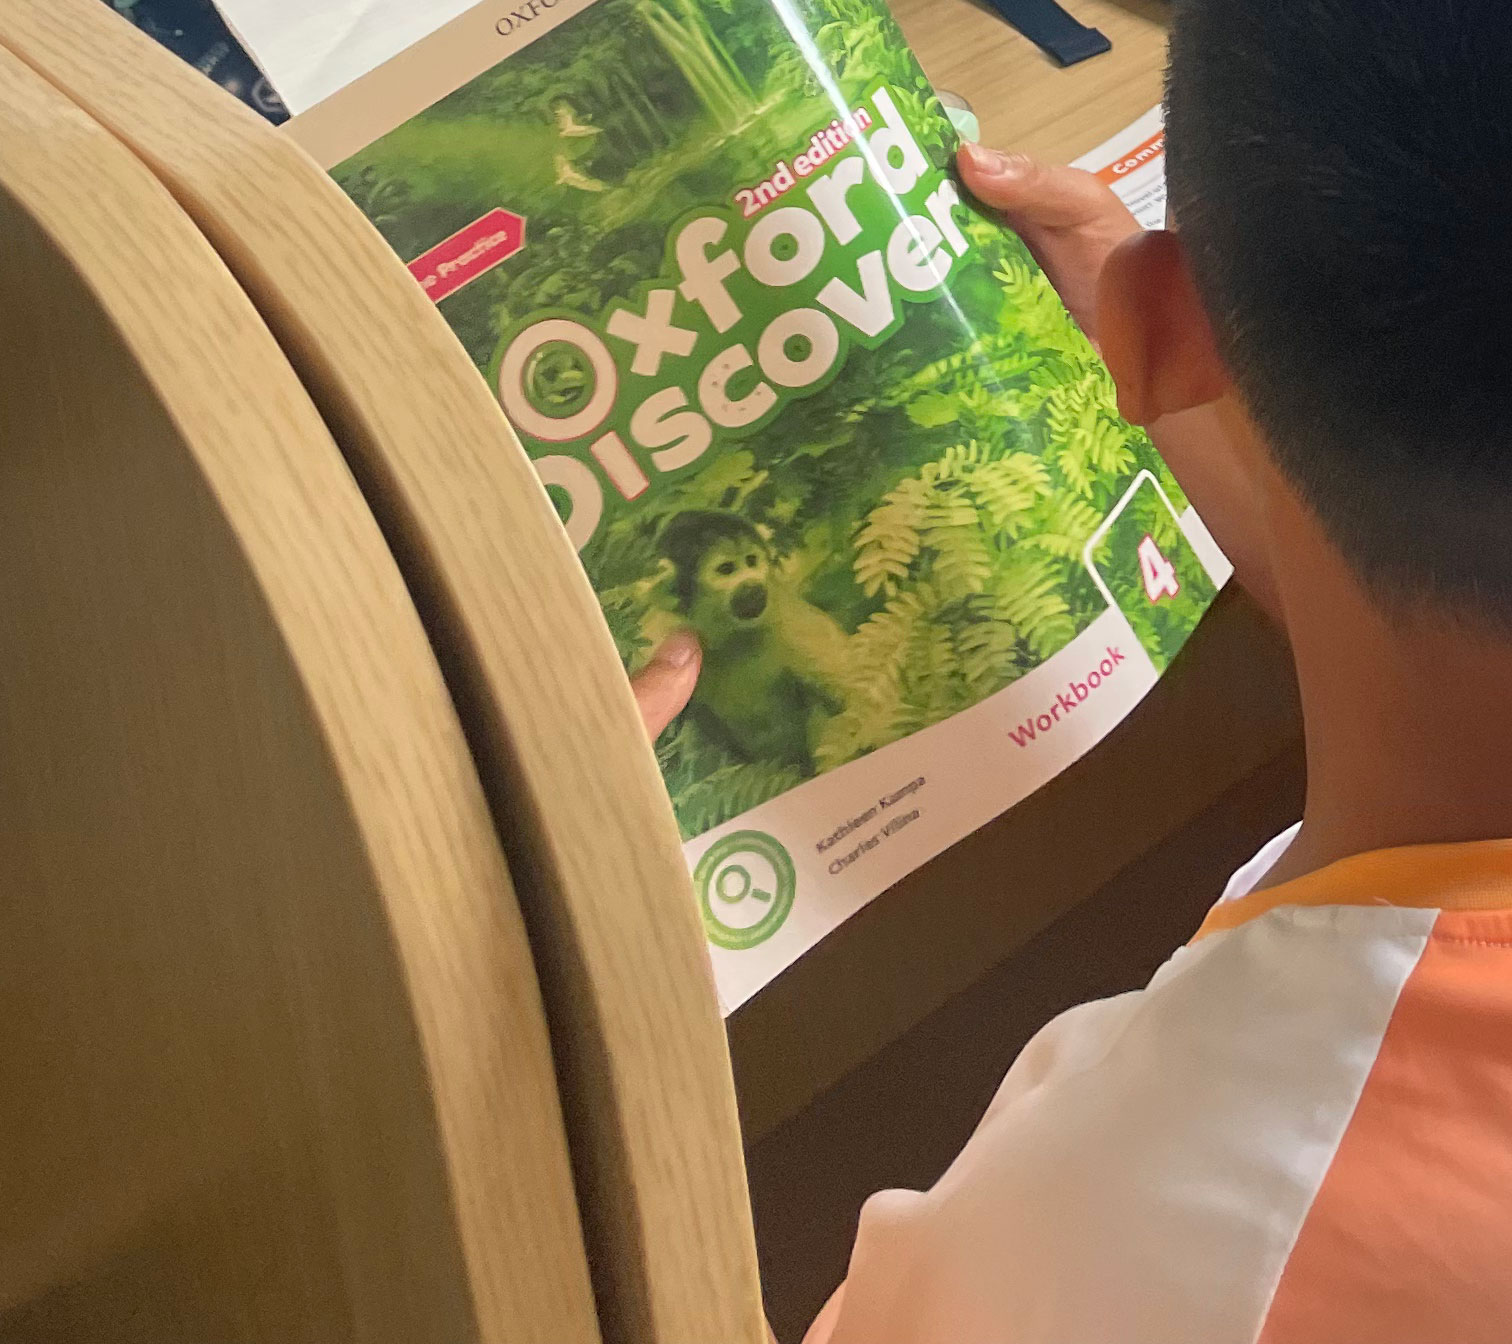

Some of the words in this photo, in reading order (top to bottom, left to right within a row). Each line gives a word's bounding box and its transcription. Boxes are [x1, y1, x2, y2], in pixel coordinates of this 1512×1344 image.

[734, 160, 797, 218] 2nd
[500, 86, 930, 442] Oxford
[1137, 532, 1181, 605] 4
[1007, 646, 1126, 748] Workbook
